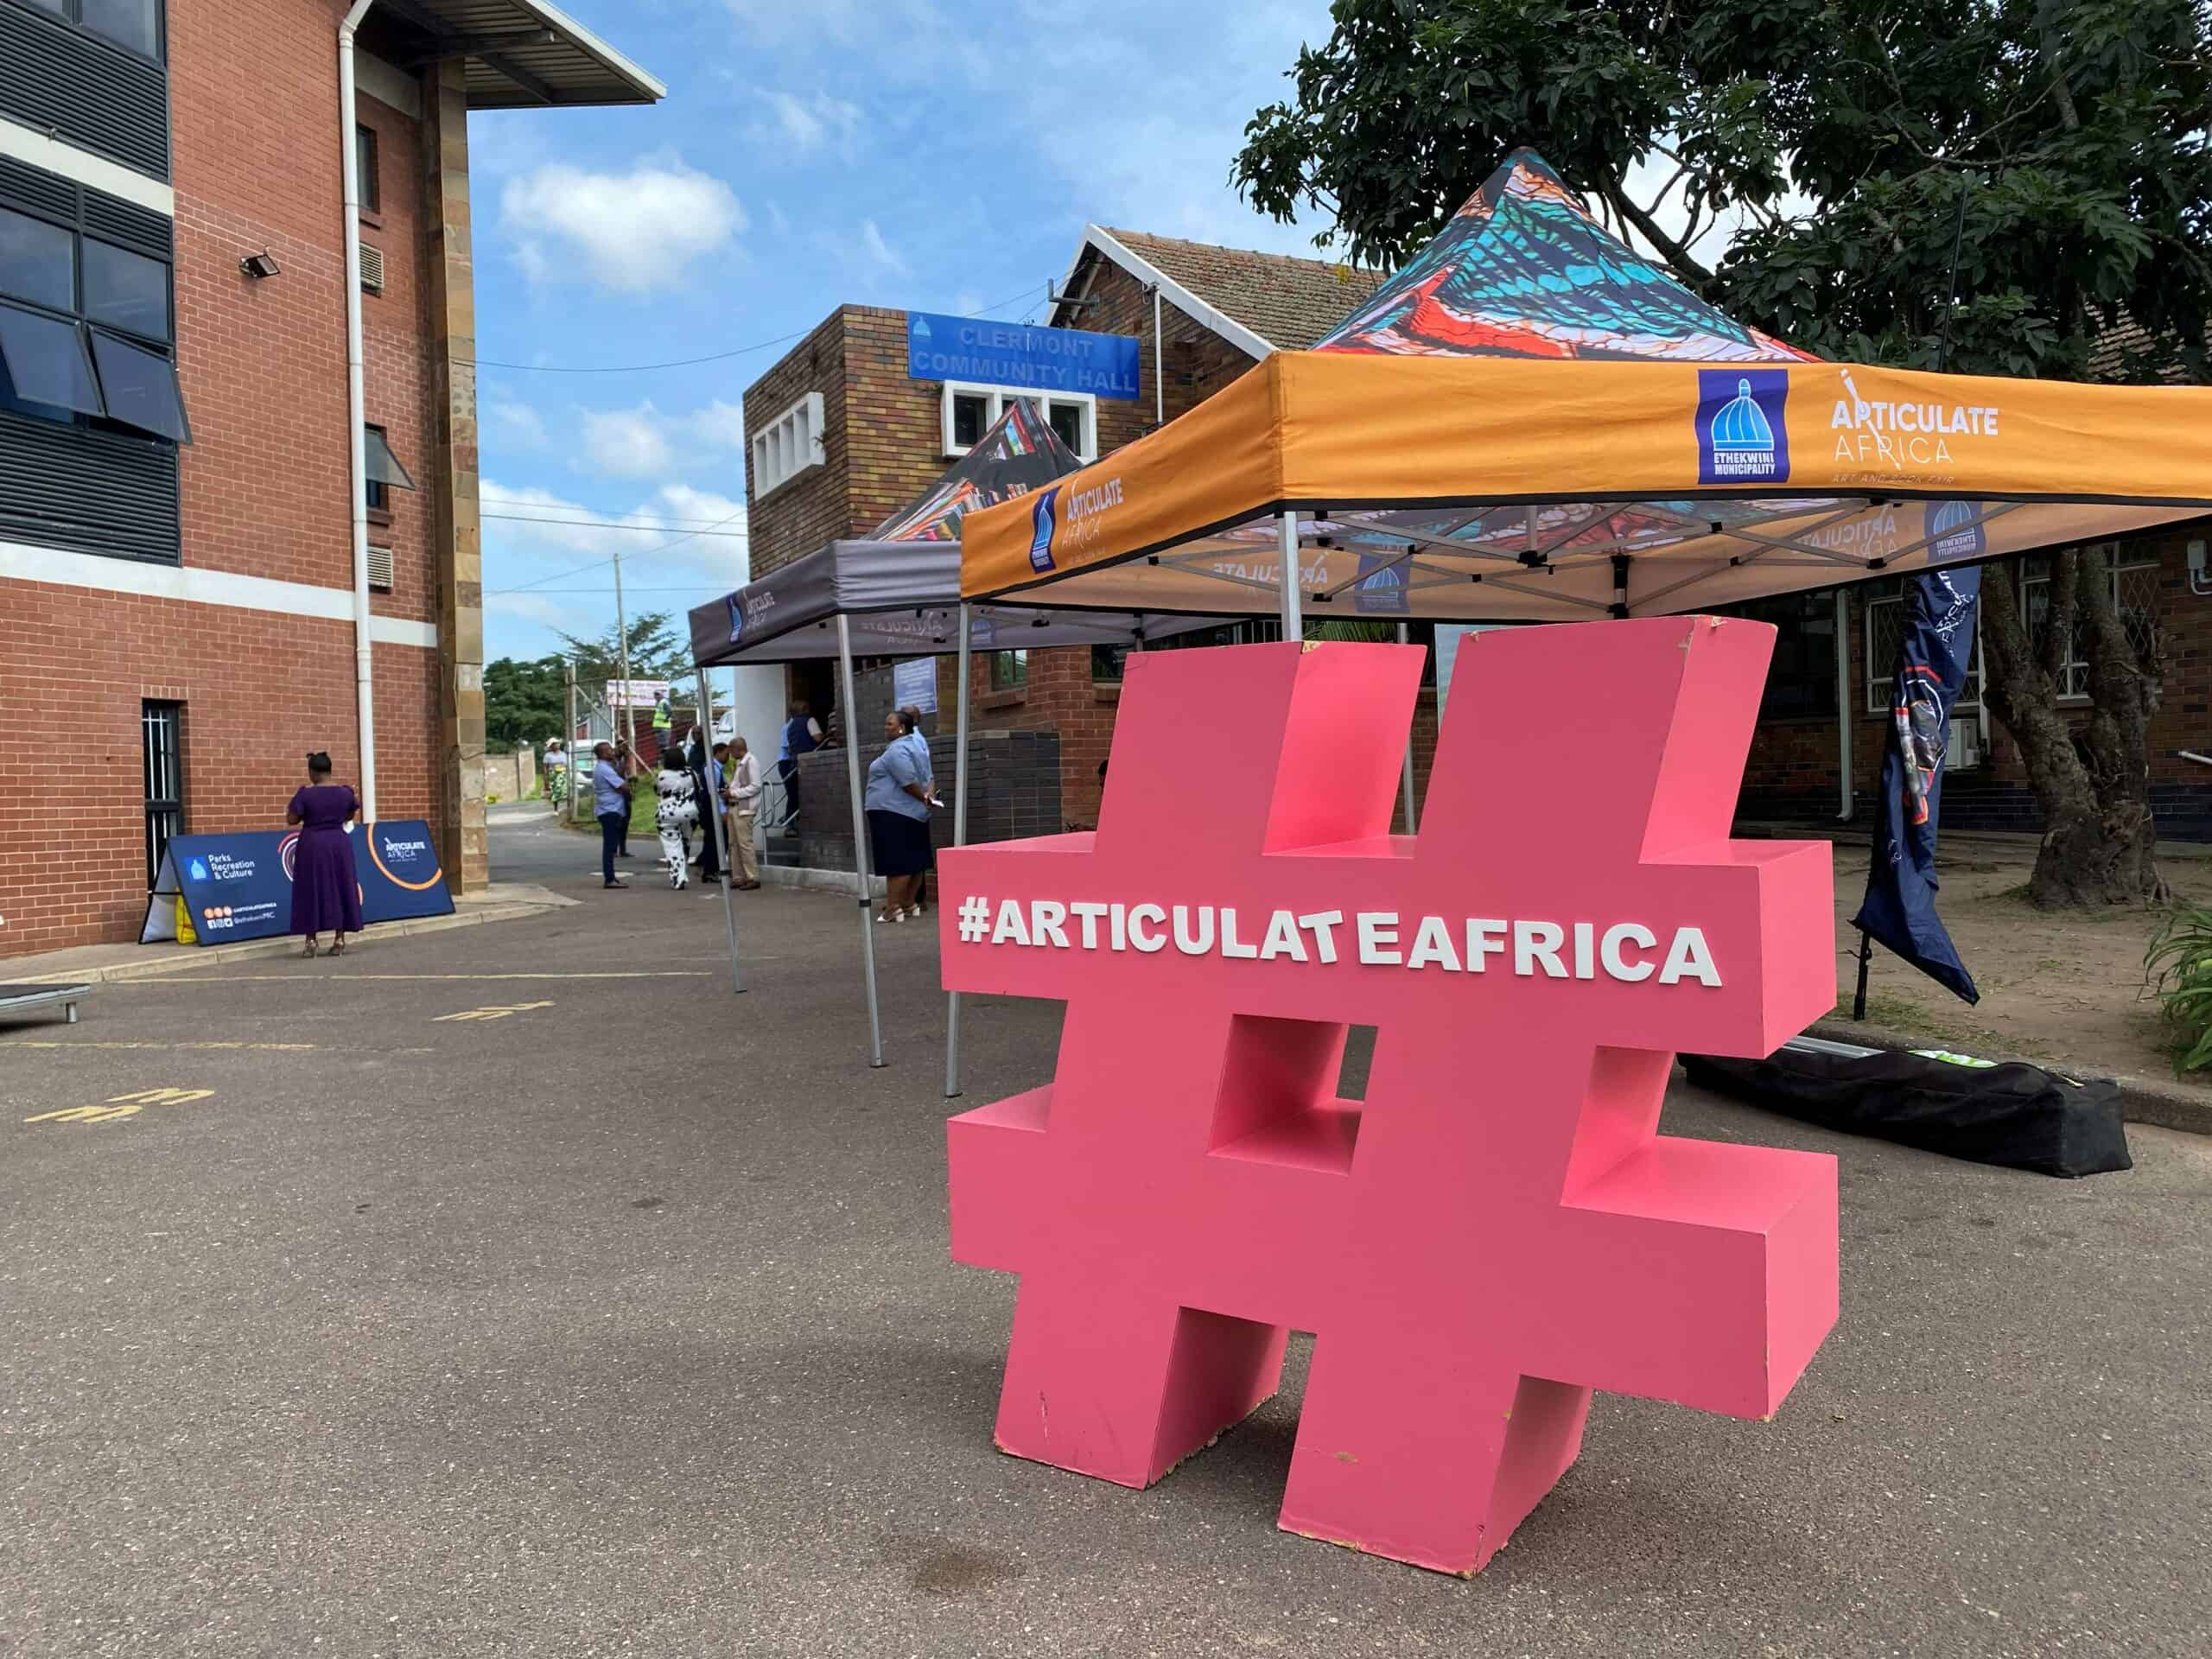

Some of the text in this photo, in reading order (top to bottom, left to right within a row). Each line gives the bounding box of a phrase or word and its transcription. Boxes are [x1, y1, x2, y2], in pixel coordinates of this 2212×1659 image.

[959, 326, 1093, 358] CLERMONT
[912, 351, 1136, 393] COMMUNITY HALL
[1830, 396, 1999, 435] ARTICULATE
[1713, 452, 1775, 464] ETHEKWINI
[1834, 434, 1955, 468] AFRICA
[1714, 463, 1776, 476] MUNICIPALITY
[1831, 474, 1857, 484] ART
[1067, 478, 1123, 522] ARTICULATE
[208, 853, 232, 863] Parks
[211, 860, 255, 872] Recreation
[214, 869, 252, 880] & Culture
[957, 895, 1724, 988] #ARTICULATEAFRICA
